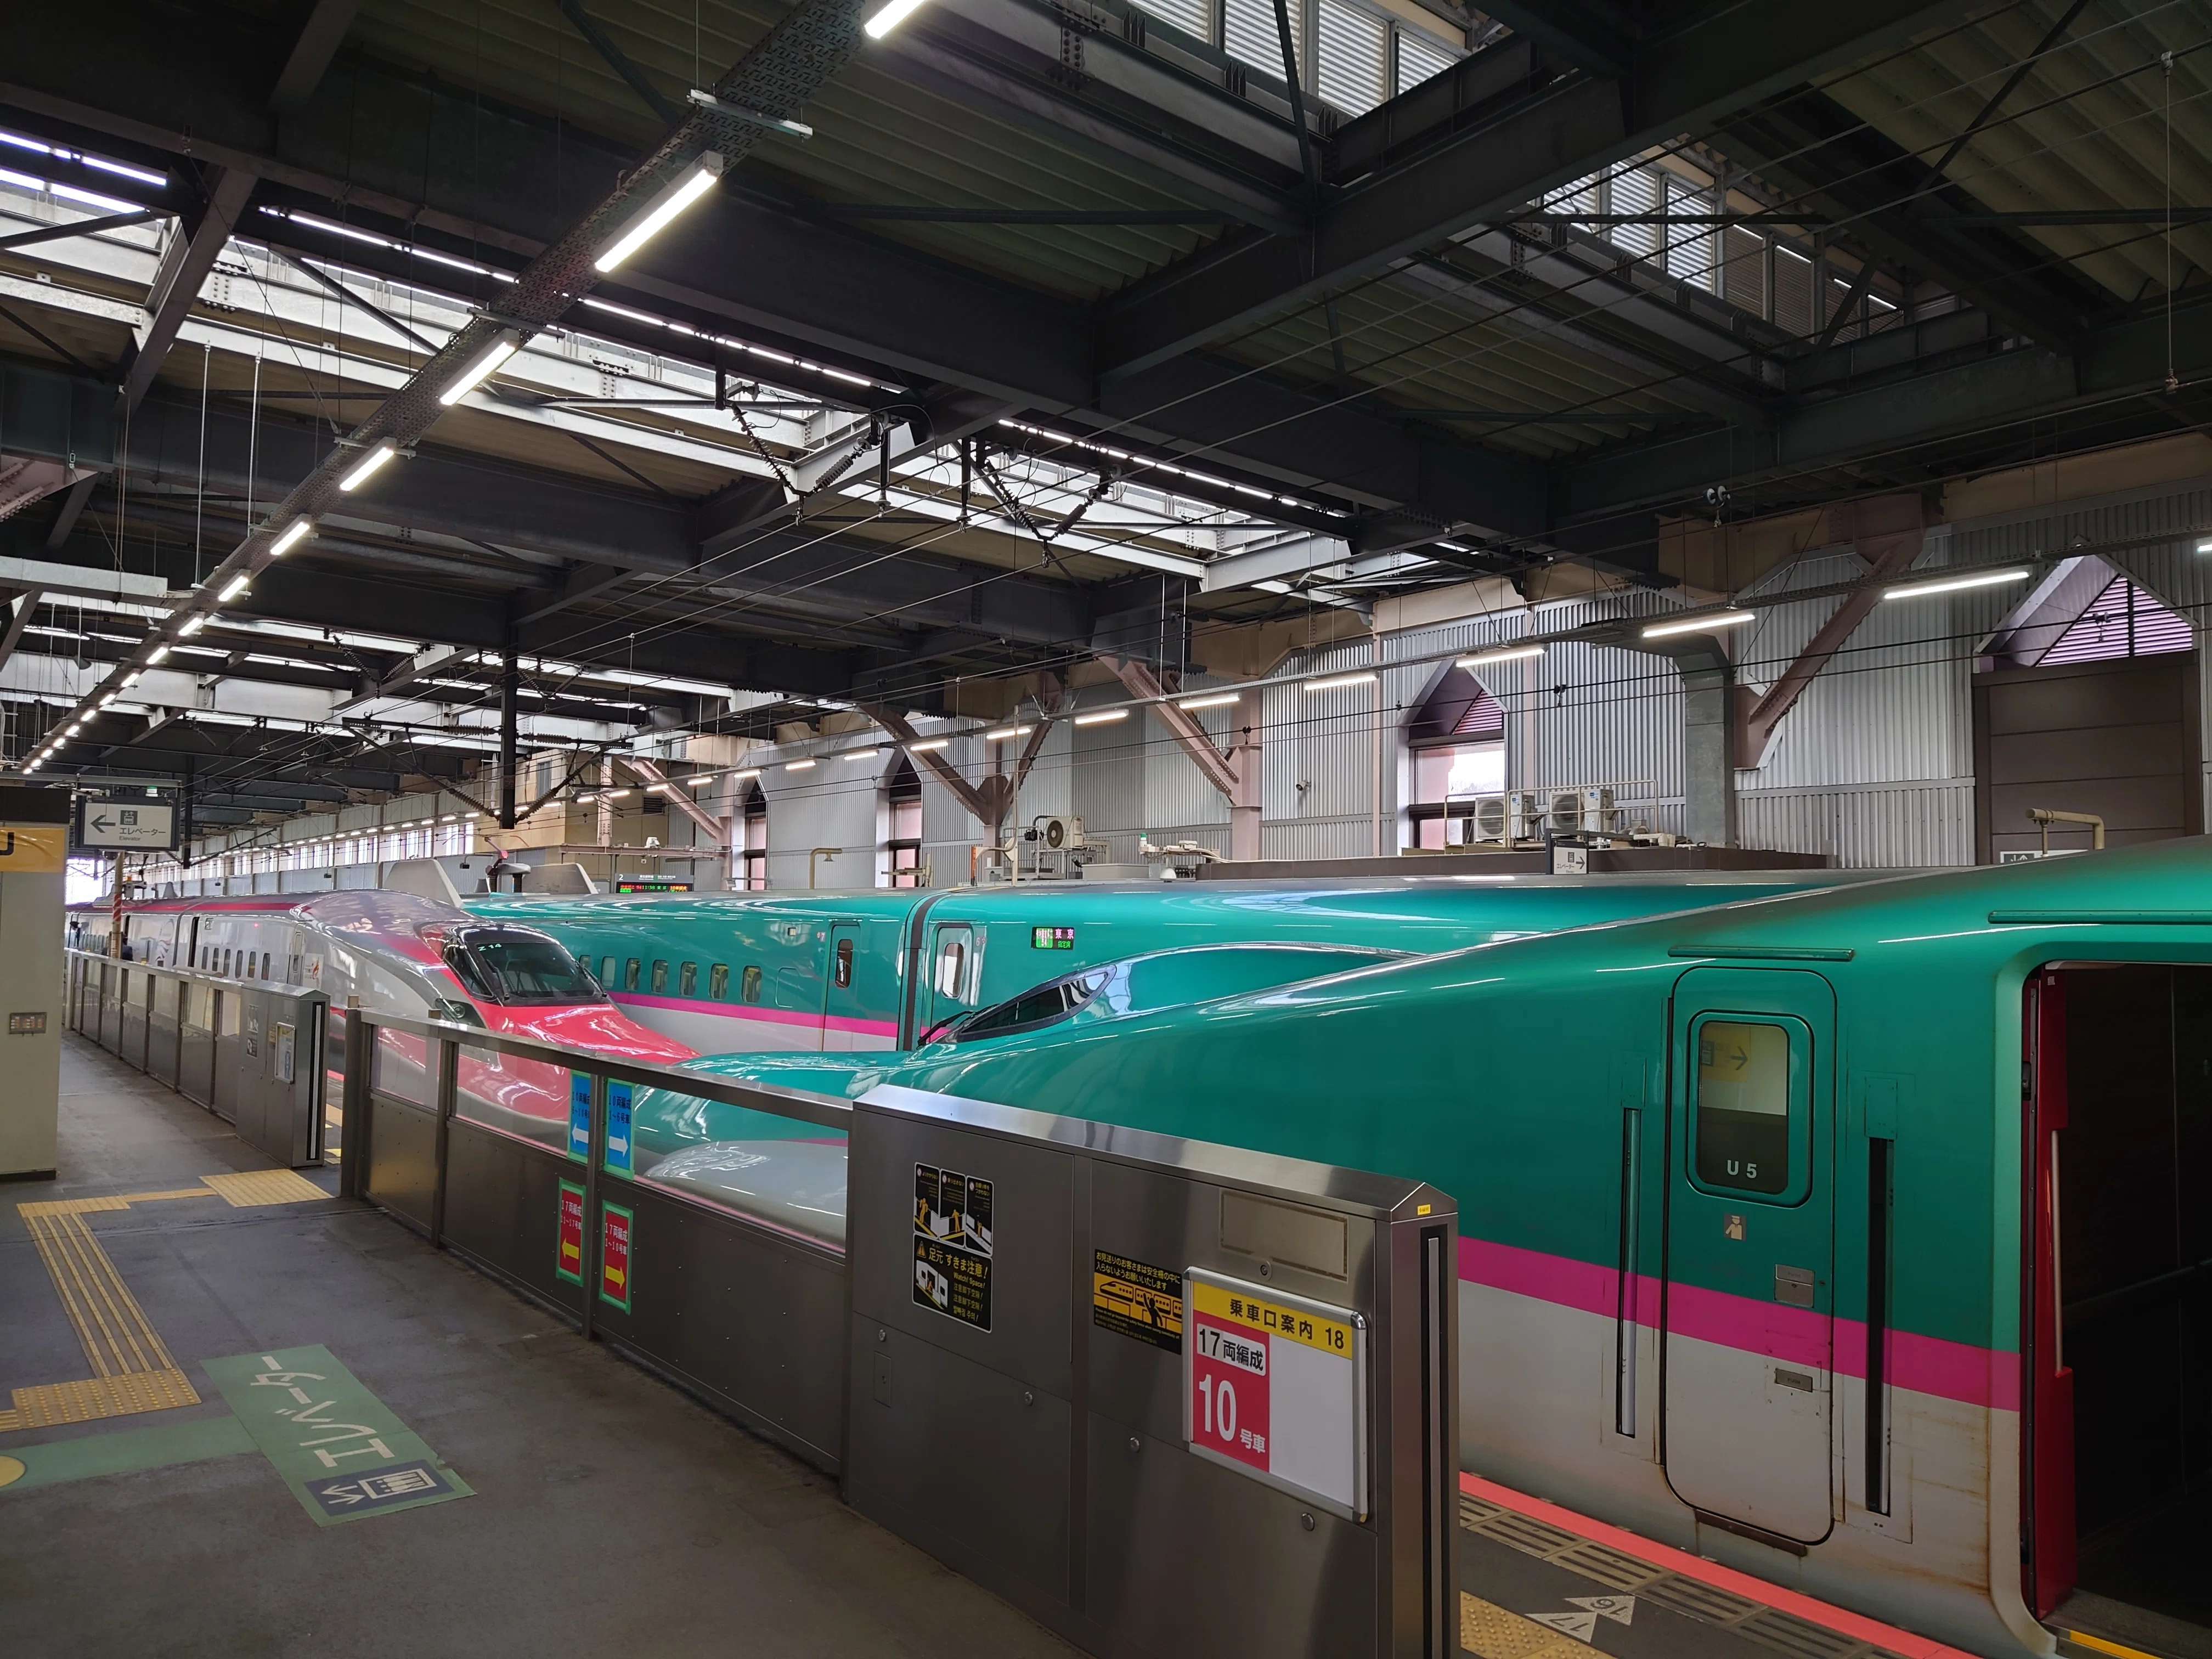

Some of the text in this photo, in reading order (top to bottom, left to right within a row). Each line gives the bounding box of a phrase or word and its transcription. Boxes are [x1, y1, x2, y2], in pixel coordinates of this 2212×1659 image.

[120, 827, 166, 836] エレベーター
[821, 933, 825, 941] 7
[976, 937, 980, 946] 6
[1055, 928, 1074, 939] 東京
[928, 1247, 944, 1264] 足元
[1229, 1298, 1345, 1350] 乗車口案内 18
[1199, 1328, 1263, 1372] 17両編成
[250, 1355, 395, 1468] エレベーター
[1590, 1598, 1628, 1616] 16
[1548, 1616, 1589, 1632] 17
